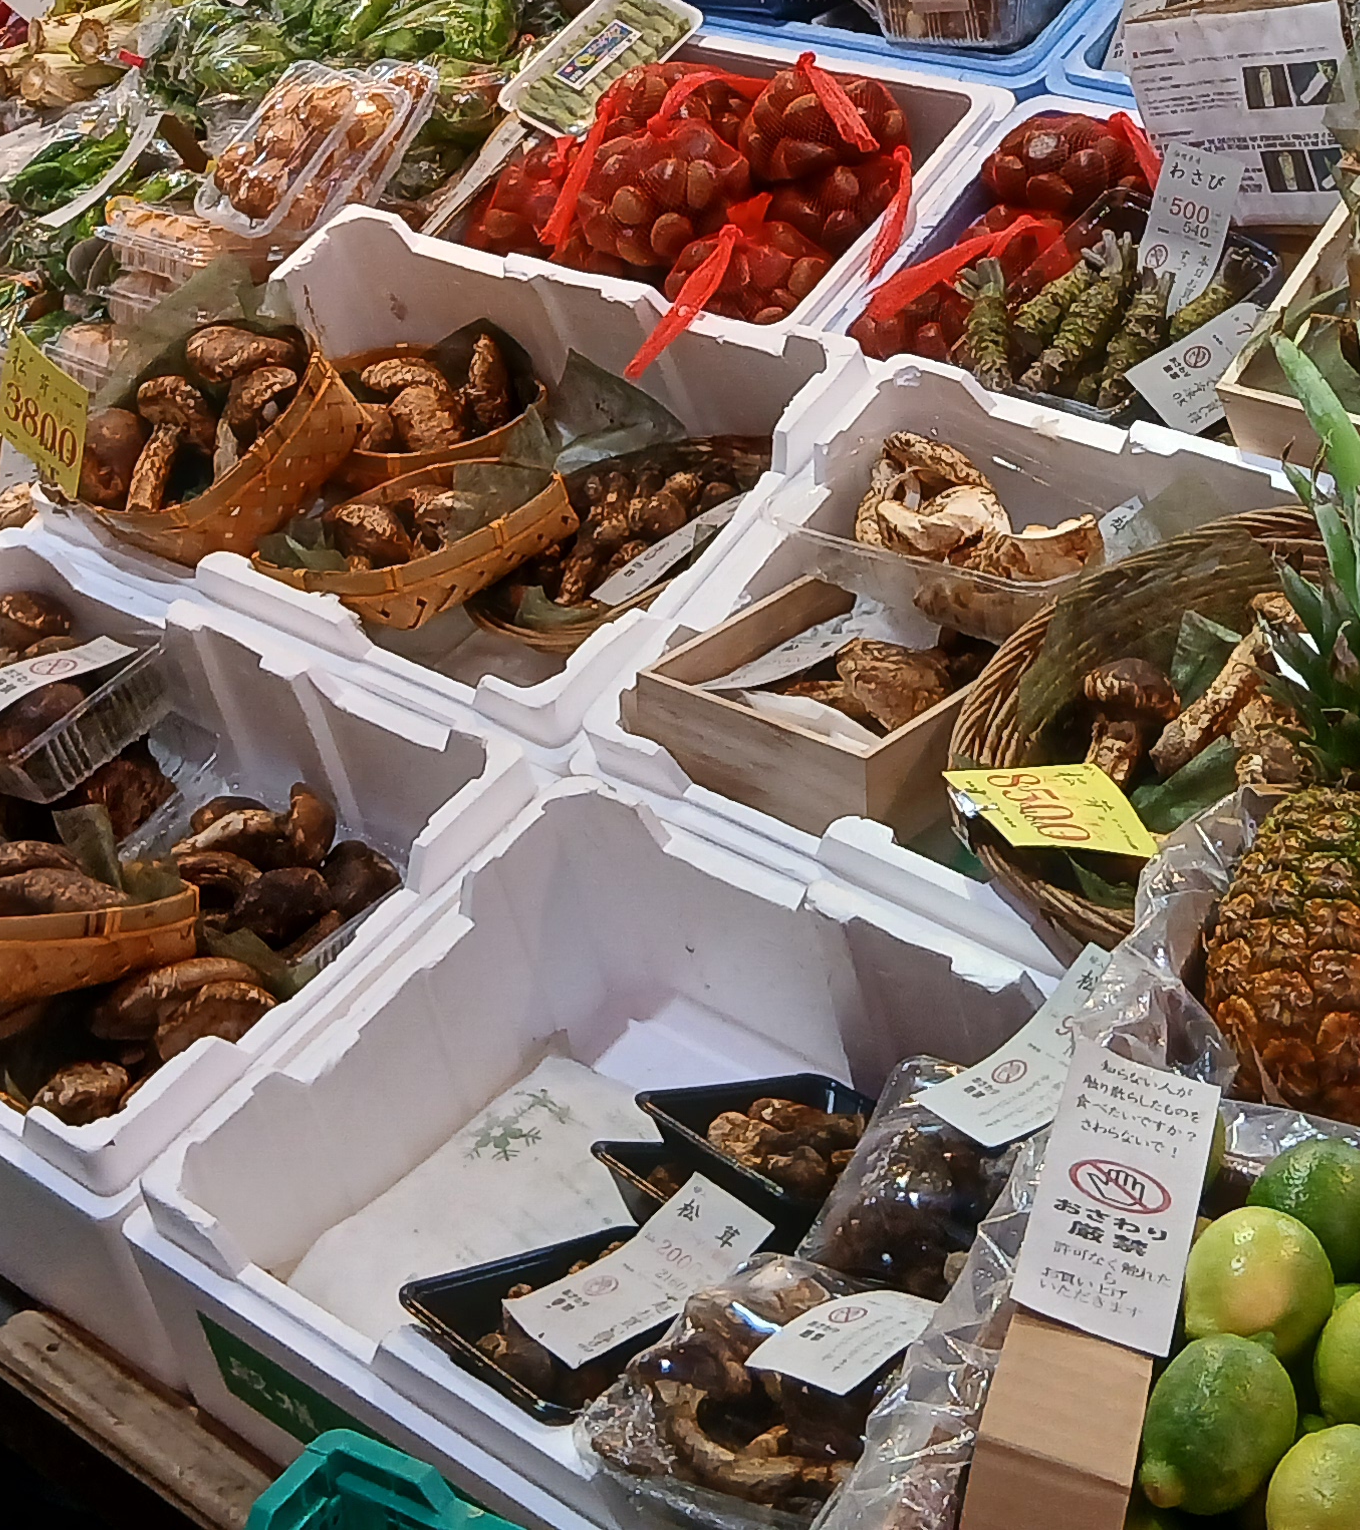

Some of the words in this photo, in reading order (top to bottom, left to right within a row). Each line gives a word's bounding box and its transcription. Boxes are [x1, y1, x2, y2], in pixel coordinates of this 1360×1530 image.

[1170, 165, 1226, 190] わさび
[1169, 198, 1210, 224] 500
[1183, 221, 1209, 239] 540
[4, 382, 77, 468] 3800
[1101, 1059, 1194, 1098] 知らない人が
[676, 1198, 741, 1249] 松茸
[1053, 1198, 1168, 1241] おさわり
[1068, 1221, 1148, 1257] 厳禁
